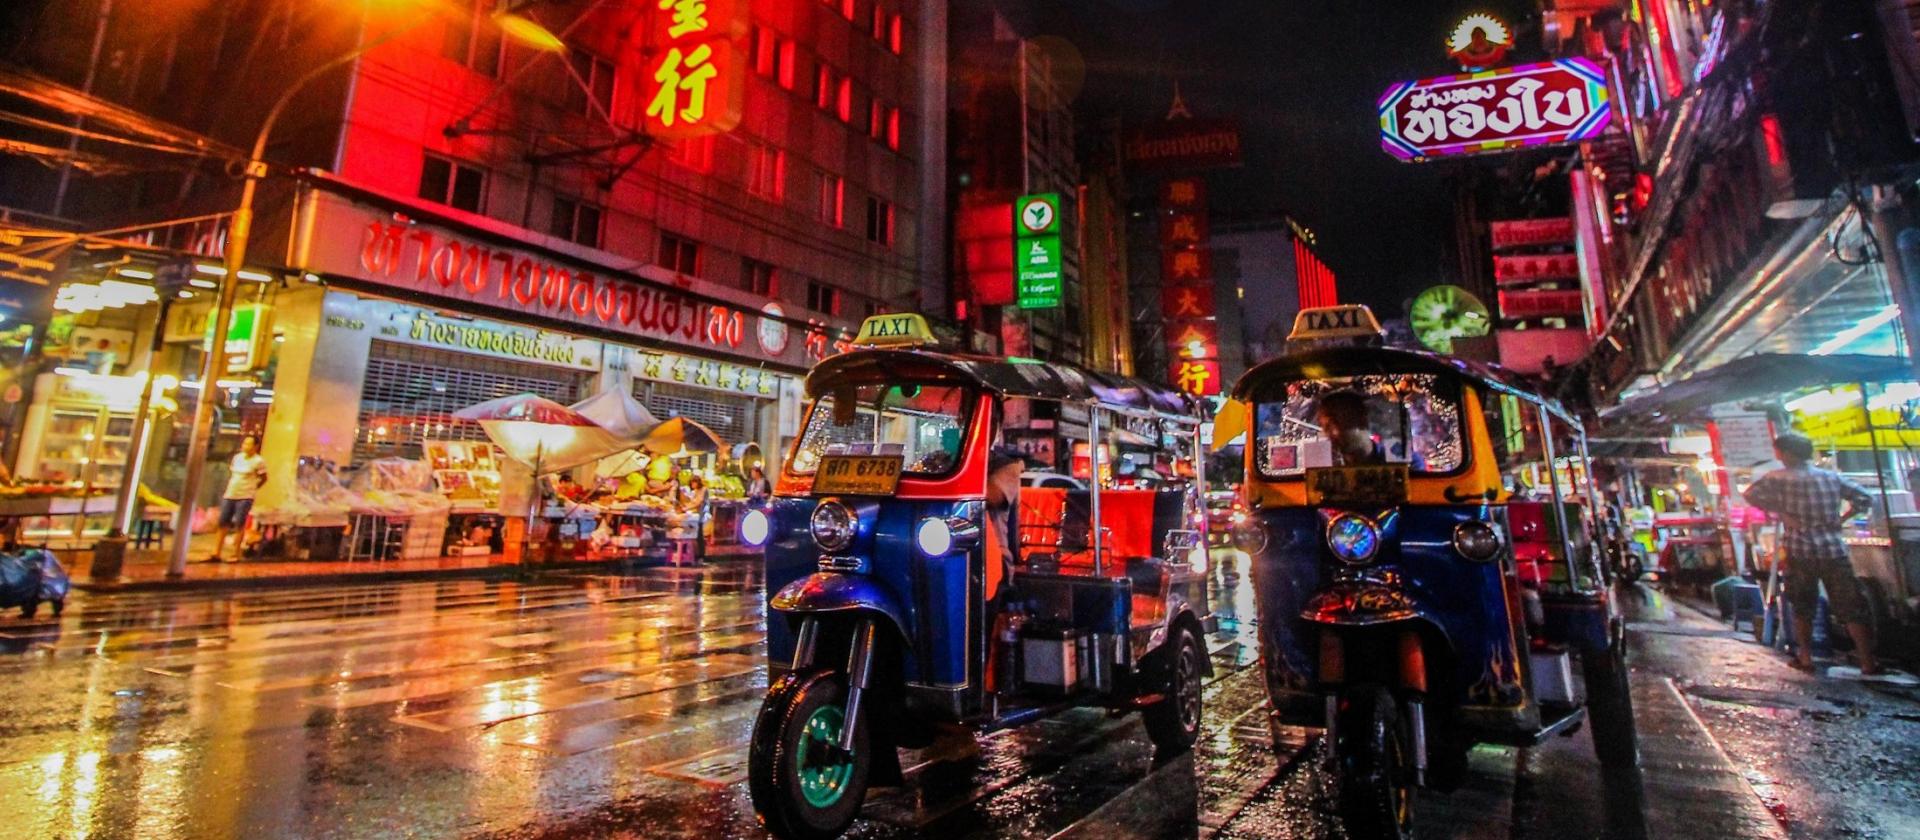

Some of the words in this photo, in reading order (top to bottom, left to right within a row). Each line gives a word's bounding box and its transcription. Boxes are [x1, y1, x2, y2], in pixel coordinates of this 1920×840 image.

[1410, 84, 1496, 109] ห้างทอง
[1403, 77, 1585, 143] ทองใบ
[869, 318, 912, 337] TAXI
[1304, 309, 1361, 330] TAXI
[857, 459, 897, 477] 6738
